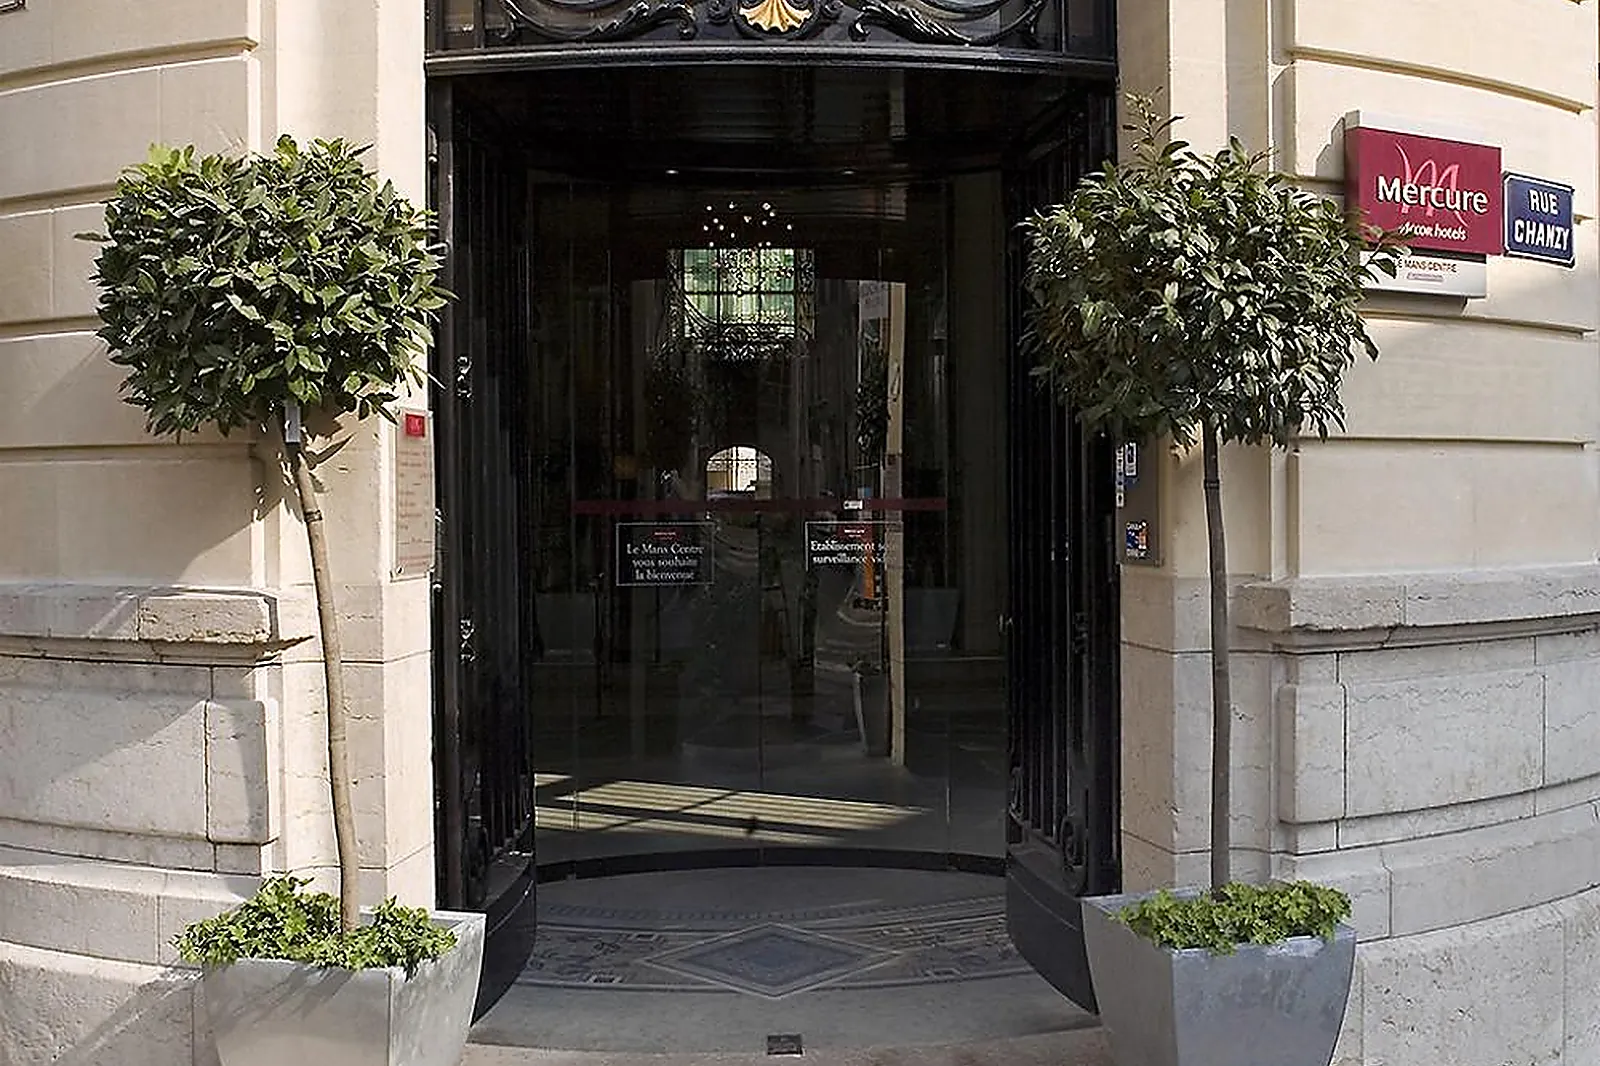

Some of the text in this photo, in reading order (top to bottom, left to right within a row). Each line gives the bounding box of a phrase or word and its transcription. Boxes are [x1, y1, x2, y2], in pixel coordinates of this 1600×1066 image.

[1377, 174, 1490, 214] Mercure
[1528, 189, 1559, 215] RUE
[1514, 219, 1570, 251] CHANZY
[626, 543, 640, 555] Le
[642, 543, 668, 555] Mans
[632, 559, 655, 569] vous
[635, 568, 694, 581] la bienvenue
